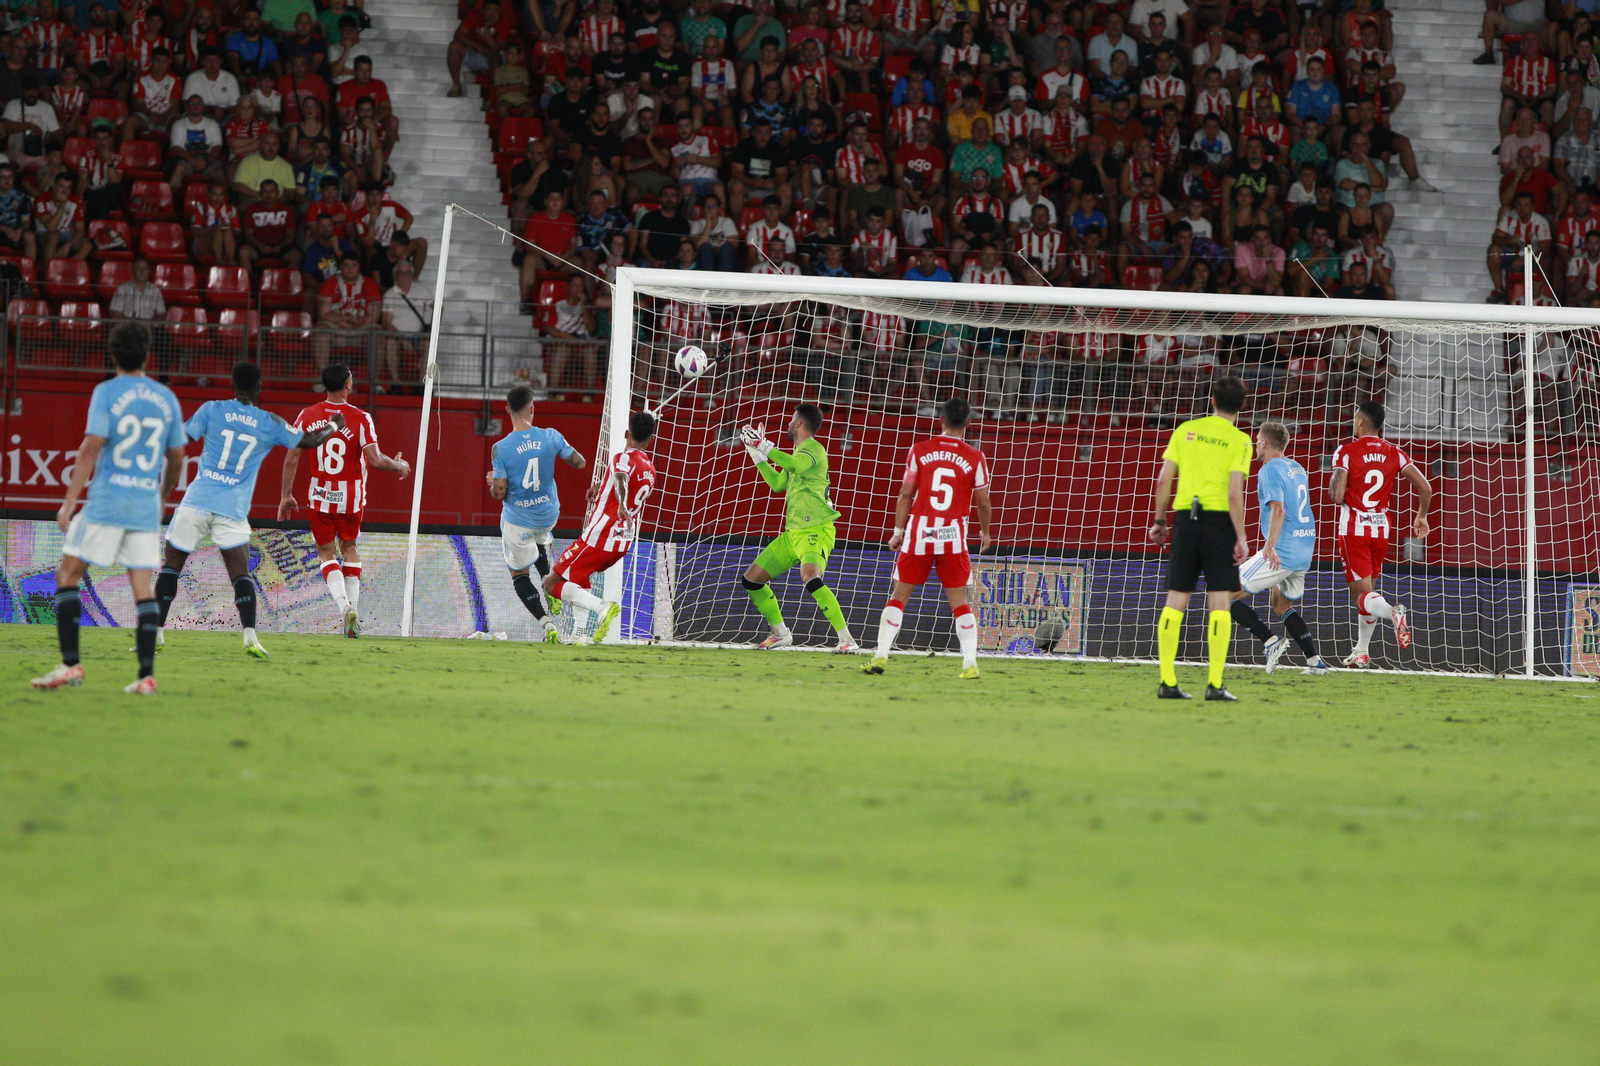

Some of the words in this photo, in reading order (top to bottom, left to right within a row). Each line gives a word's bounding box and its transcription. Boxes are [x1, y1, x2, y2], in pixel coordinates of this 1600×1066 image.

[225, 412, 258, 428] BAMBA
[113, 414, 165, 471] 23
[217, 429, 258, 474] 17
[317, 437, 346, 475] 18
[516, 440, 542, 454] NÚÑEZ
[1362, 453, 1387, 463] KAIKY
[522, 457, 541, 492] 4
[920, 451, 973, 474] ROBERTONE
[628, 484, 650, 517] 9
[930, 467, 956, 511] 5
[1297, 484, 1310, 523] 2
[1362, 469, 1384, 508] 2
